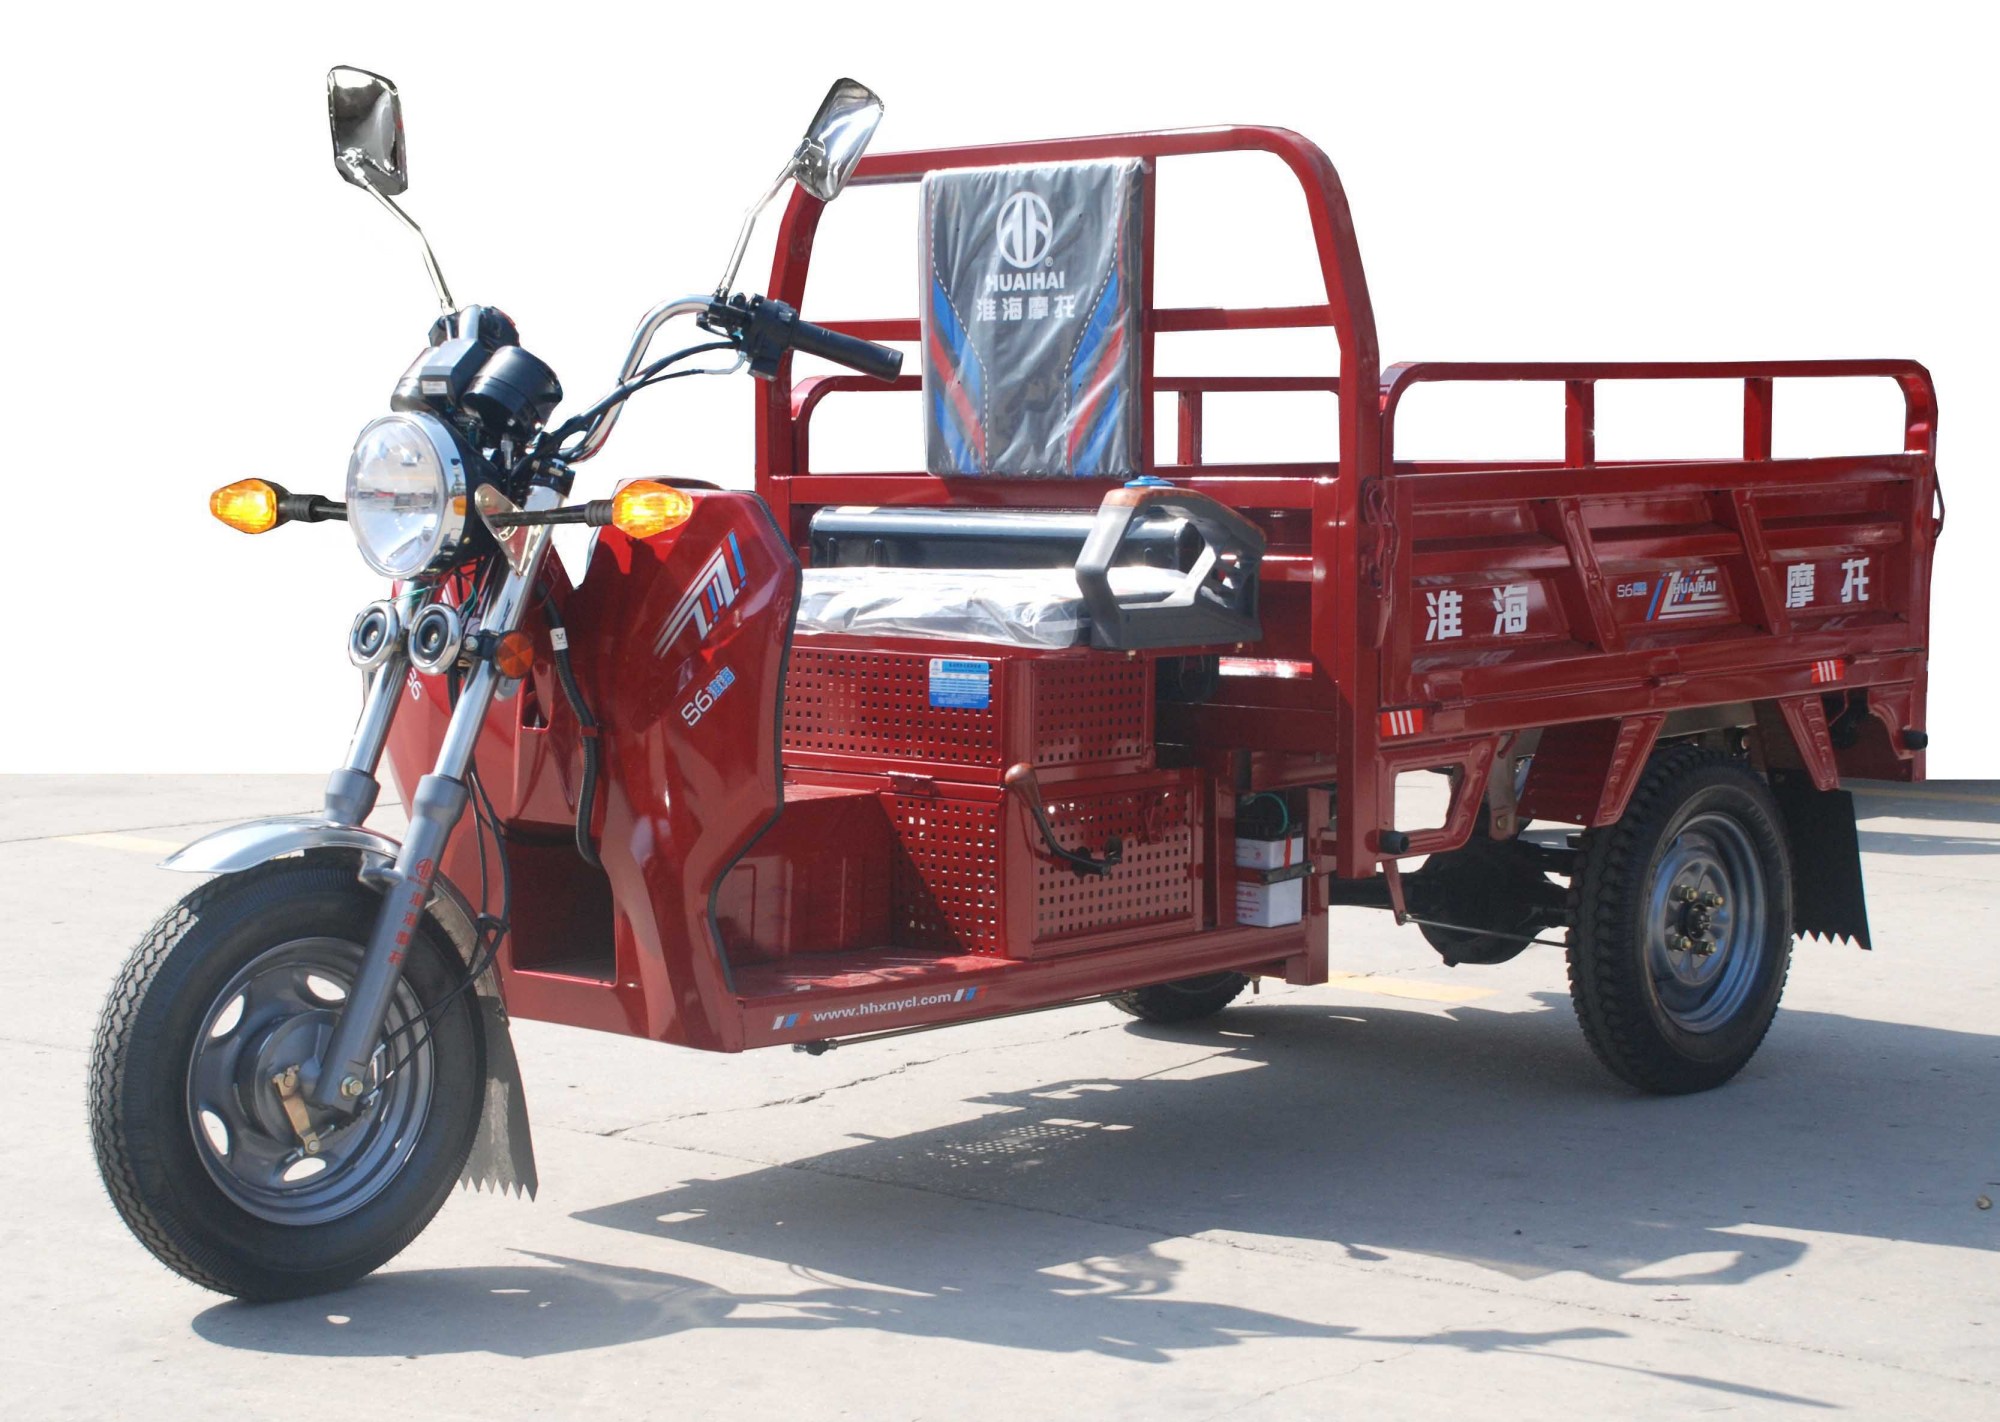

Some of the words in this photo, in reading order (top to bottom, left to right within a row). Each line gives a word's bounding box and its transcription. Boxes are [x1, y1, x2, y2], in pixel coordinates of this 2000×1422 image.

[985, 271, 1065, 292] HUAIHAI
[976, 294, 1076, 322] 淮海摩托
[1672, 580, 1717, 594] HUAIHAI
[1785, 557, 1870, 609] 摩托
[1425, 584, 1529, 641] 淮海
[813, 992, 952, 1022] www.hhxnycl.com
